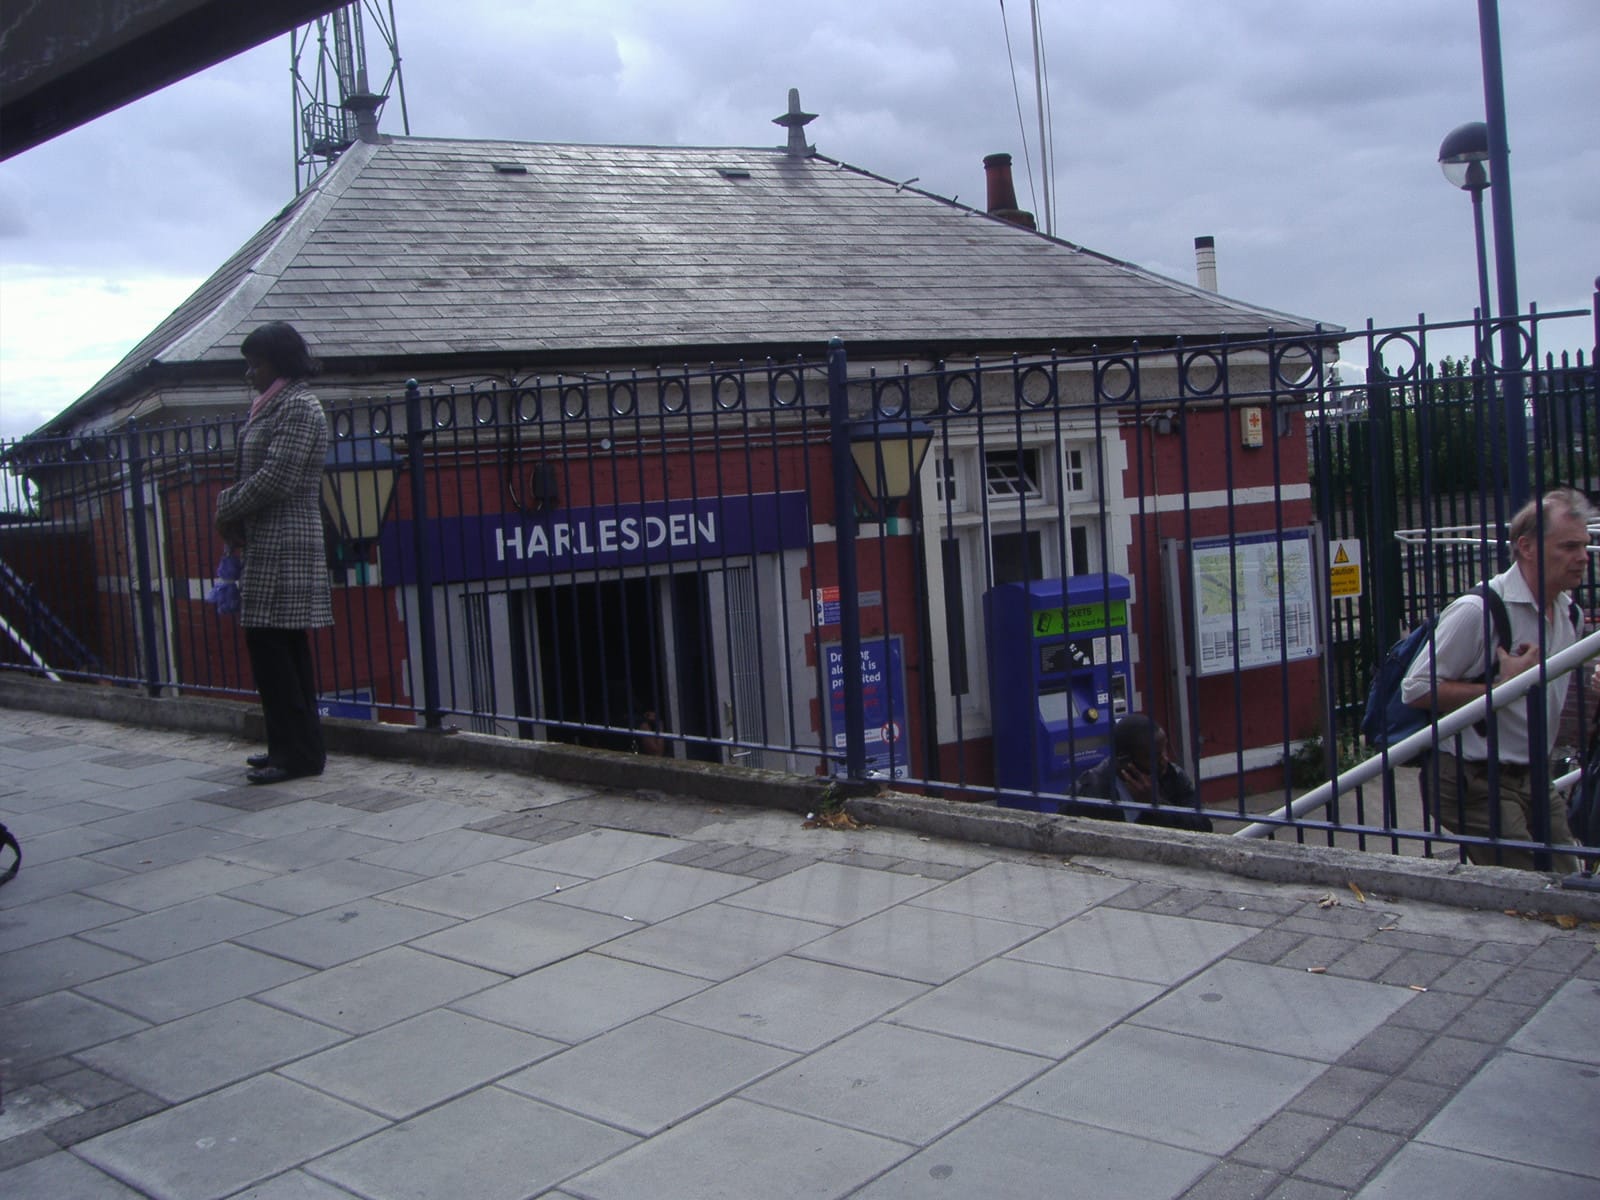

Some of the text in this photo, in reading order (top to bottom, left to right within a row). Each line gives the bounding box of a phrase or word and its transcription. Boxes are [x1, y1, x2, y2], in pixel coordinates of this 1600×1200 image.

[495, 511, 716, 561] HARLESDEN
[1060, 607, 1092, 619] TCKETS
[868, 660, 876, 671] is
